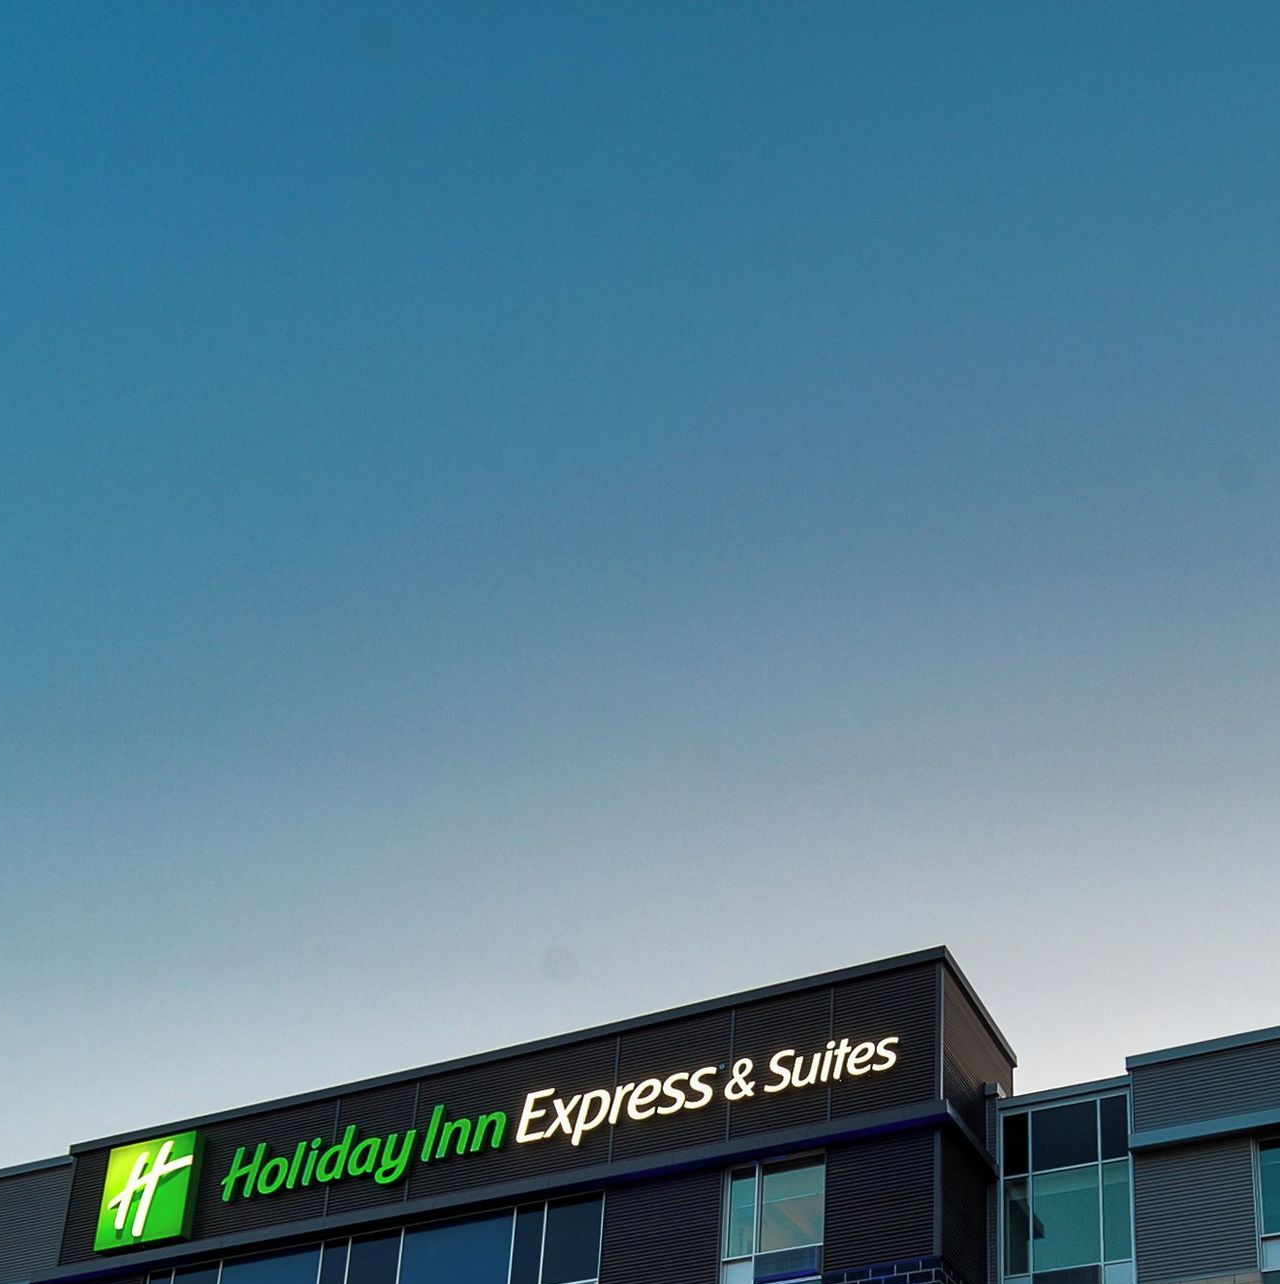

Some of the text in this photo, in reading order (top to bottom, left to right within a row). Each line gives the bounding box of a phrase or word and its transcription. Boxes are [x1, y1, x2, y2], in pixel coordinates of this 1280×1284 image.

[221, 1036, 899, 1202] Holiday Inn Express & Suites
[108, 1140, 193, 1238] H
